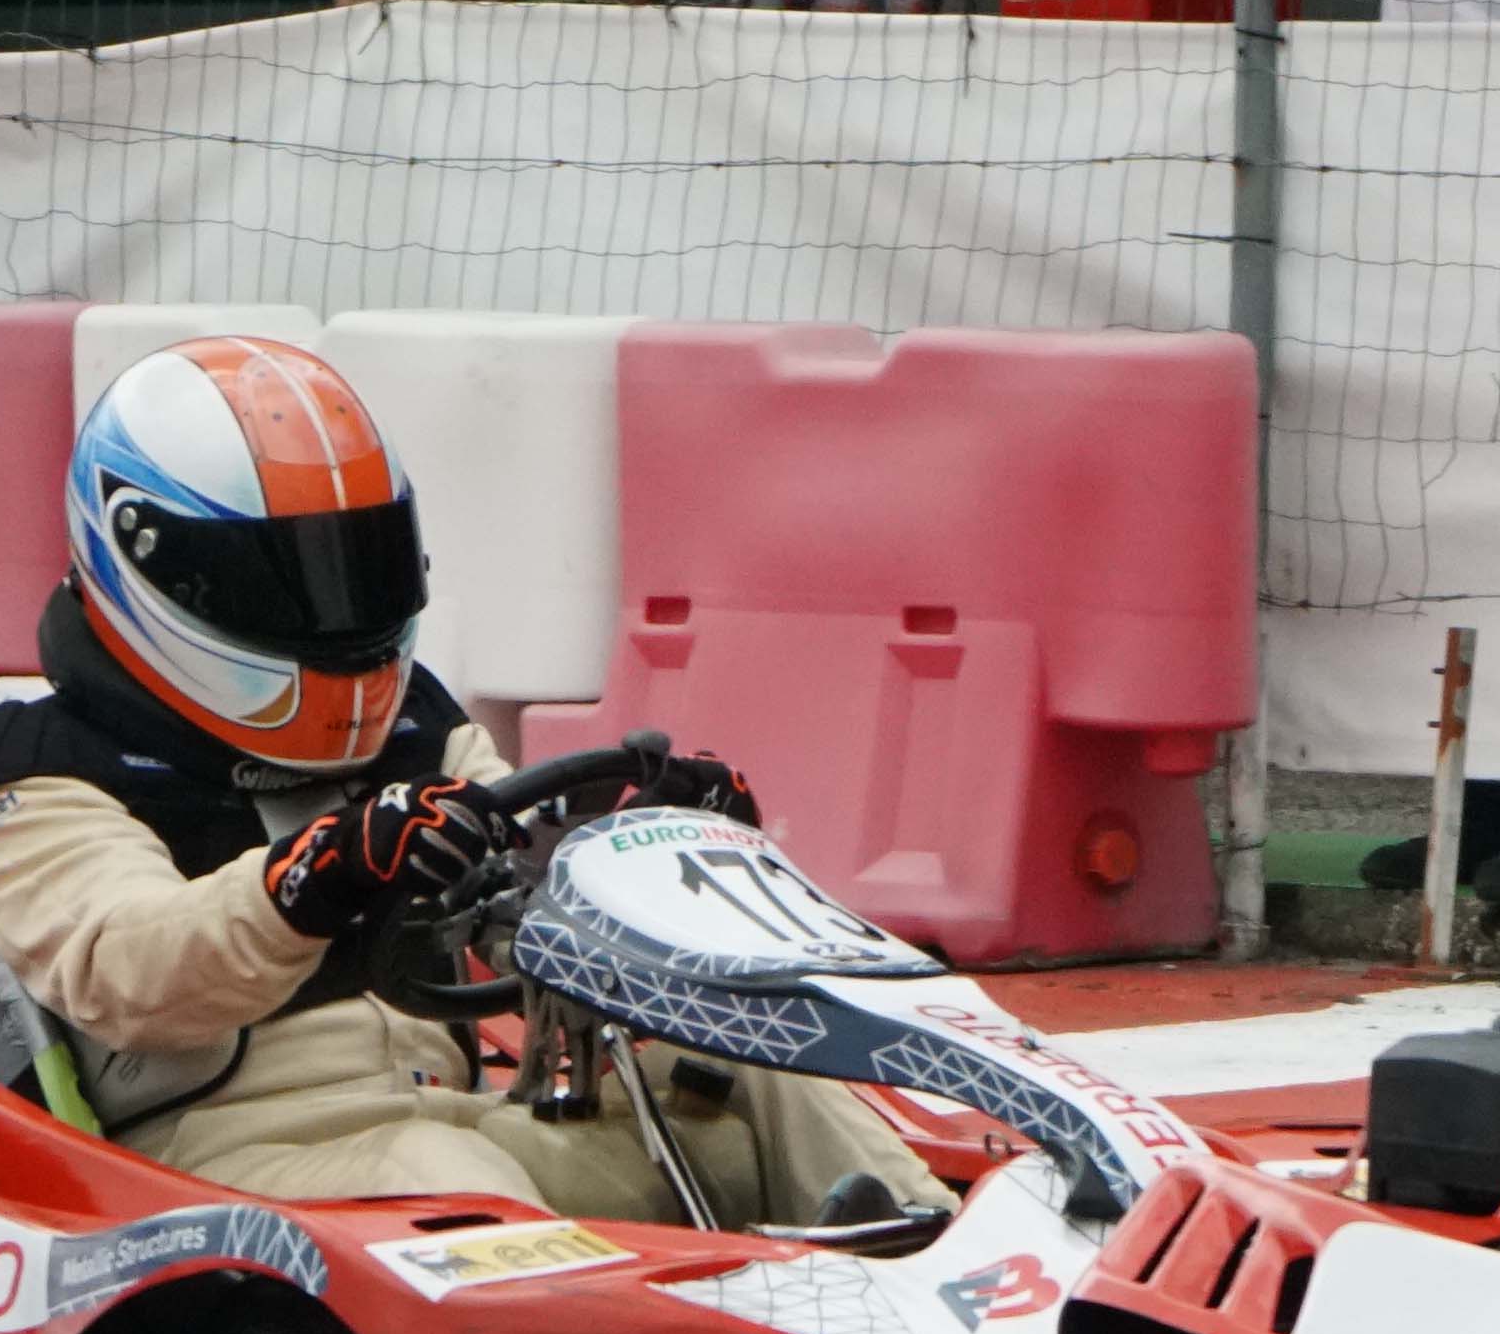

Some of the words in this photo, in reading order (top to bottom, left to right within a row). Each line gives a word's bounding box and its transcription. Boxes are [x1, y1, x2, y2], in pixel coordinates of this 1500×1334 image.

[610, 824, 770, 854] EUROINDY
[675, 850, 888, 942] 173
[114, 1223, 208, 1270] Structures
